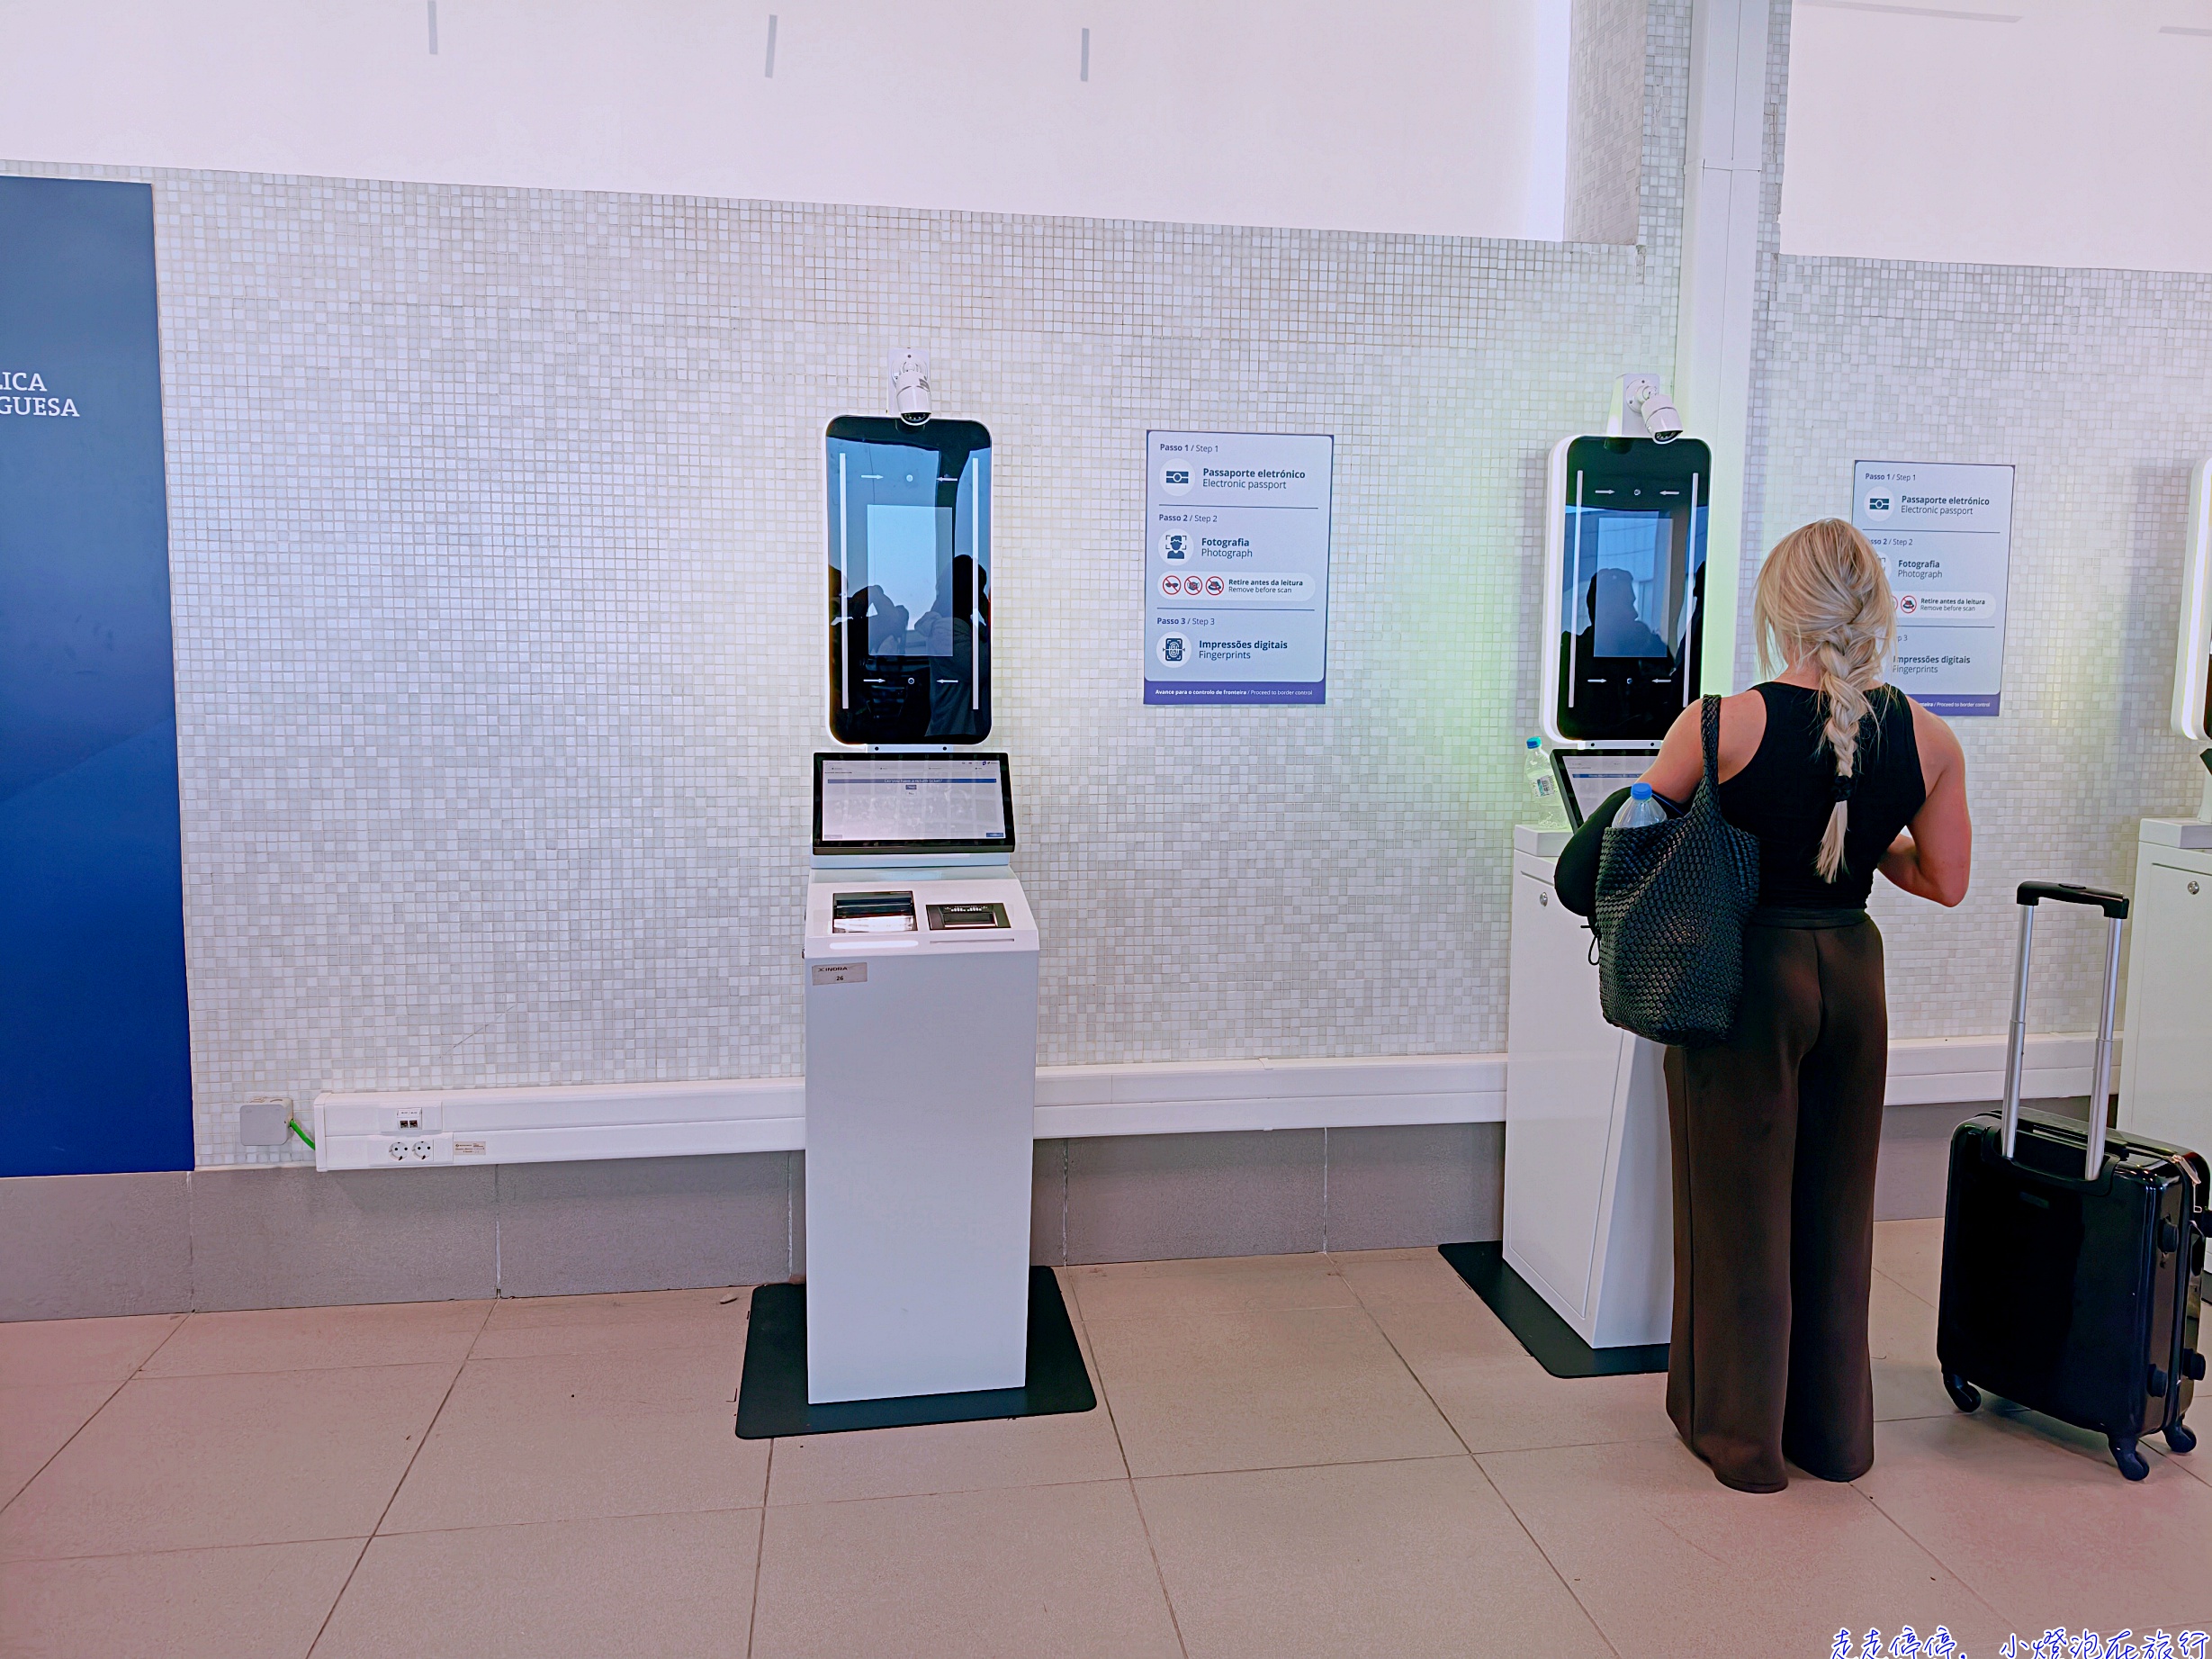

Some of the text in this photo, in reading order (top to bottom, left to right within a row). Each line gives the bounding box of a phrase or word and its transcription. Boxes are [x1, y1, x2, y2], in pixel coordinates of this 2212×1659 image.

[1196, 445, 1213, 454] Step
[1203, 468, 1306, 479] Passaporte eletrónico
[1896, 473, 1911, 482] Step
[1202, 479, 1287, 491] Electronic passport
[1902, 495, 1990, 506] Passaporte eletrónico
[1901, 505, 1974, 516] Electronic passport
[1182, 514, 1188, 522] 2
[1194, 515, 1211, 523] Step
[1201, 538, 1250, 548] Fotografia
[1893, 538, 1908, 547] Step
[1909, 538, 1913, 546] 2
[1201, 548, 1253, 559] Photograph
[1898, 560, 1940, 569] Fotografia
[1897, 570, 1943, 580] Photograph
[1191, 618, 1209, 627] Step
[1199, 640, 1288, 651] Impressões digitais
[1199, 651, 1251, 661] Fingerprints
[1941, 655, 1971, 665] digitais
[1893, 665, 1938, 675] Fingerprints
